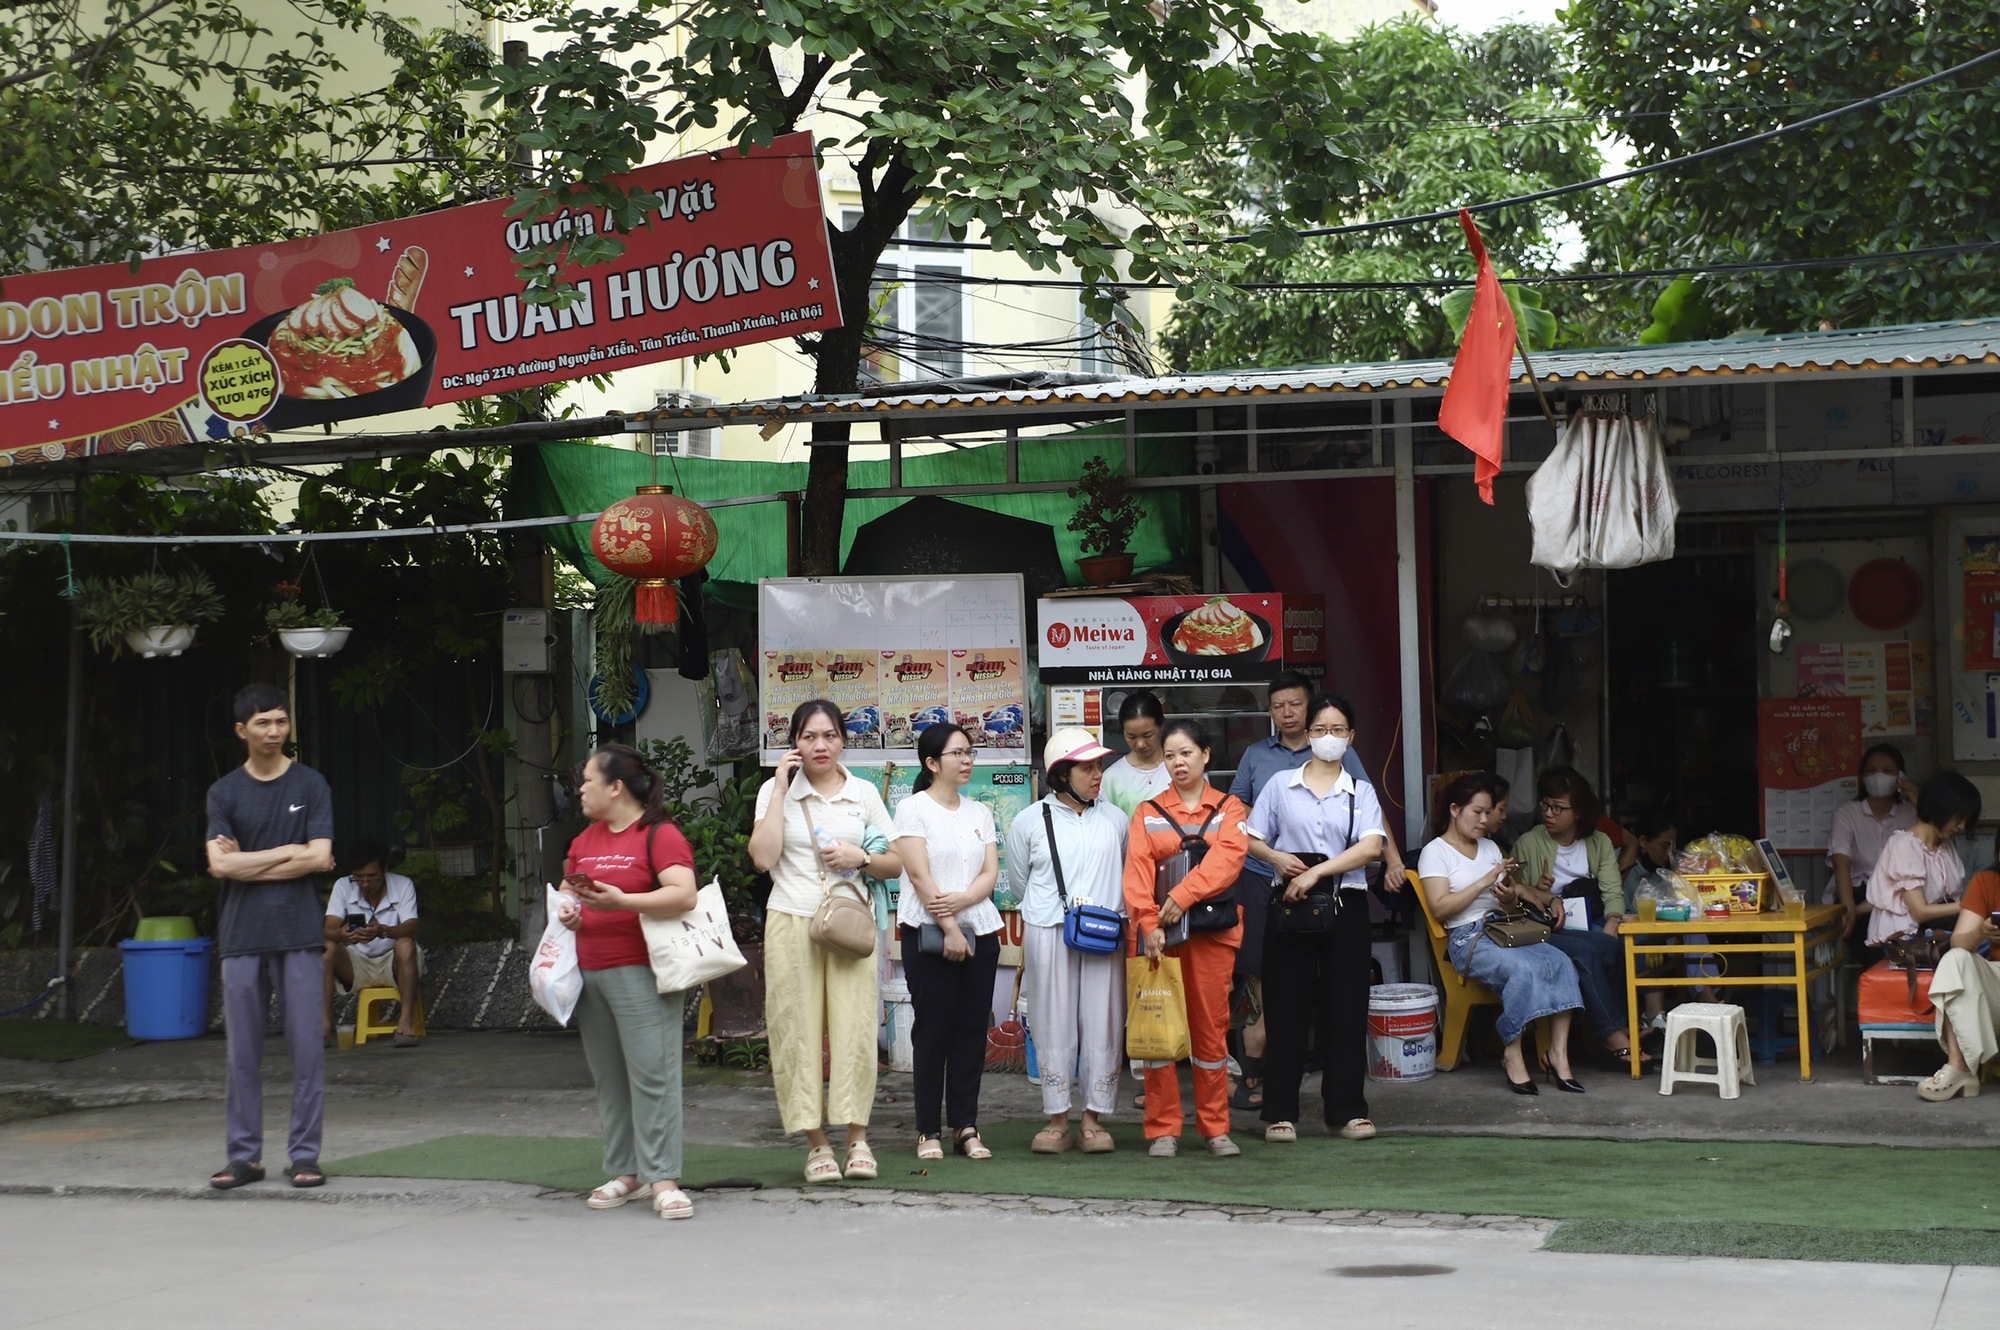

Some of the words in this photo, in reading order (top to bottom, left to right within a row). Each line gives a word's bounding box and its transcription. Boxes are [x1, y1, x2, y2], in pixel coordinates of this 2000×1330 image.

[506, 209, 595, 254] Quán
[654, 181, 715, 221] Vặt
[607, 240, 796, 320] HƯƠNG
[107, 268, 246, 328] TRỘN
[442, 376, 464, 389] ĐC:
[465, 369, 490, 387] Ngõ
[492, 365, 515, 380] 214
[518, 357, 556, 375] đường
[558, 344, 605, 368] Nguyễn
[640, 337, 662, 352] Tân
[664, 328, 700, 347] Triều,
[702, 321, 740, 339] Thanh
[743, 314, 778, 331] Xuân,
[781, 308, 798, 323] Hà
[801, 304, 823, 320] Nội
[71, 342, 189, 394] NHẬT
[211, 362, 233, 374] KÈM
[235, 361, 240, 369] 1
[241, 356, 262, 368] CÂY
[209, 375, 237, 391] XÚC
[239, 370, 271, 386] XÍCH
[247, 387, 270, 400] 47G
[1073, 623, 1135, 642] Meiwa
[785, 674, 803, 682] NISSIN
[834, 673, 853, 682] NISSIN
[902, 673, 922, 682] NISSIN
[974, 671, 994, 681] NISSIN
[1088, 668, 1114, 681] NHÀ
[1117, 667, 1152, 681] HÀNG
[1154, 666, 1187, 682] NHẬT
[1189, 669, 1208, 681] TẠI
[1211, 668, 1232, 679] GIA
[1955, 701, 1974, 724] ALU
